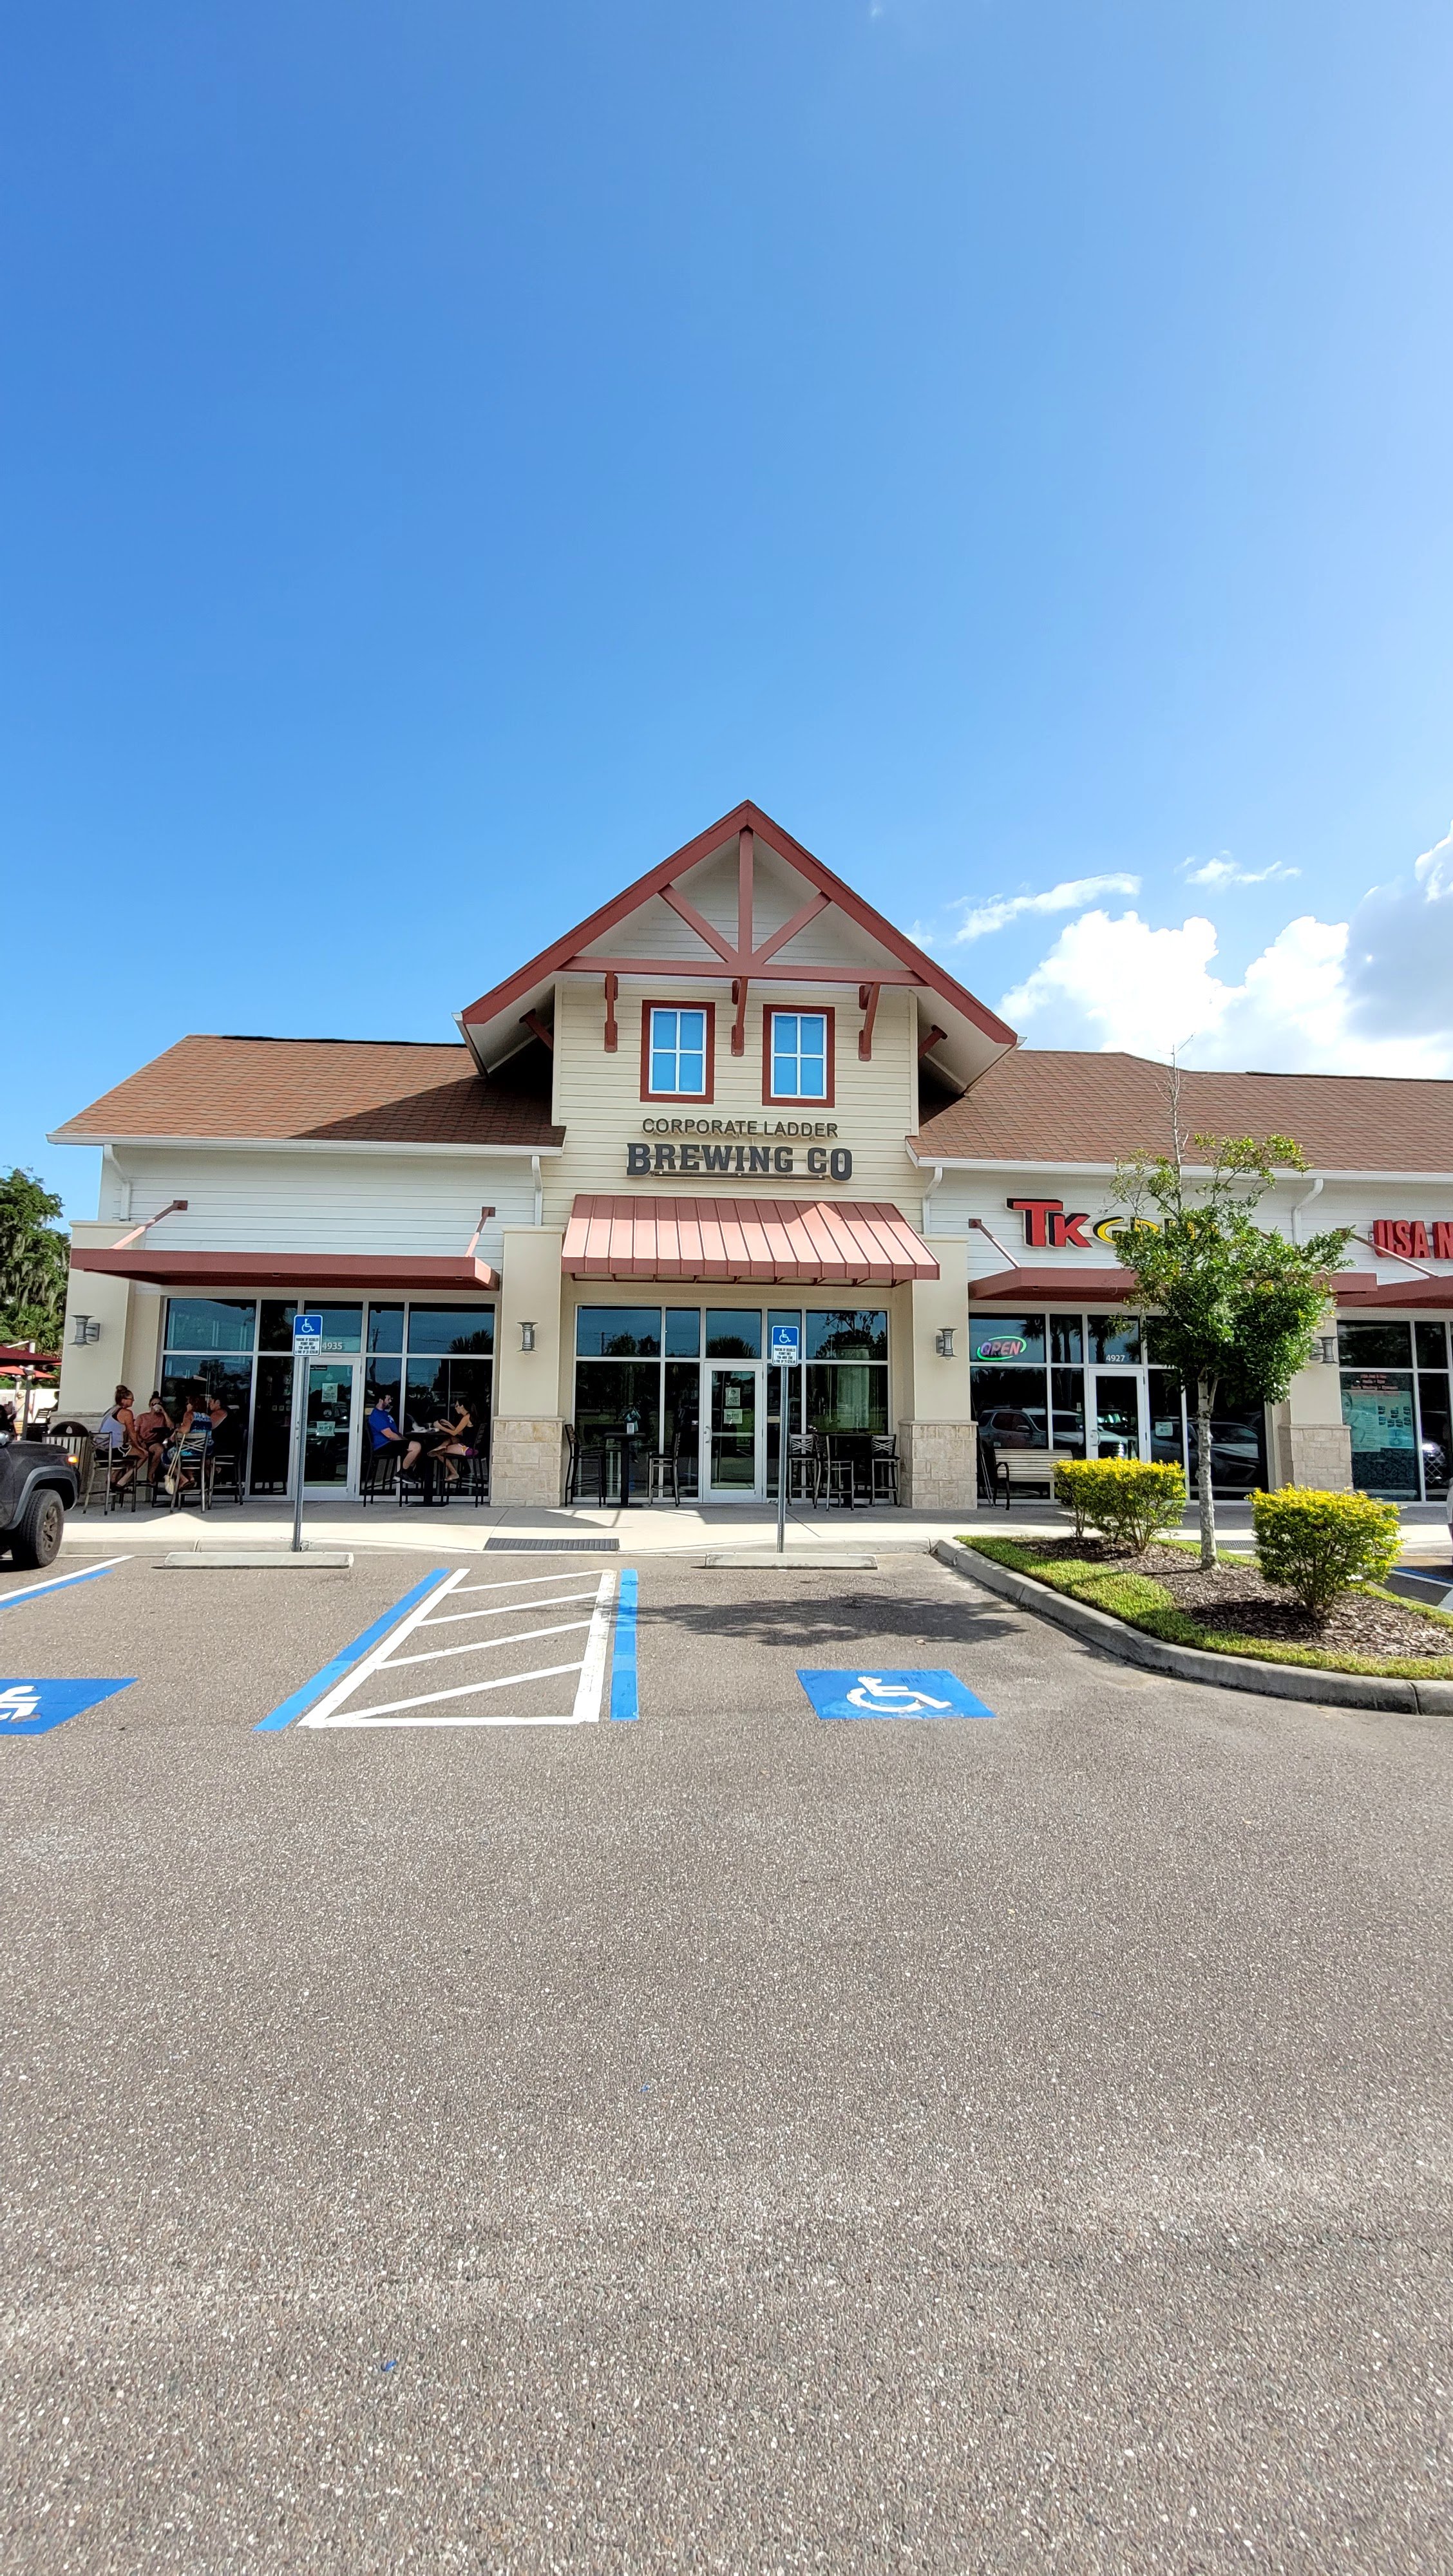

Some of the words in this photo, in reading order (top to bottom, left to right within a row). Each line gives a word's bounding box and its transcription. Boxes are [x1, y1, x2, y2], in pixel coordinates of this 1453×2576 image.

[642, 1118, 758, 1135] CORPORATE
[764, 1121, 839, 1138] LADDER
[627, 1142, 793, 1176] BREWING
[806, 1146, 853, 1182] CO
[1373, 1219, 1431, 1258] USA
[322, 1341, 343, 1350] 4935
[980, 1341, 1021, 1356] OPEN
[1106, 1354, 1126, 1363] 4927
